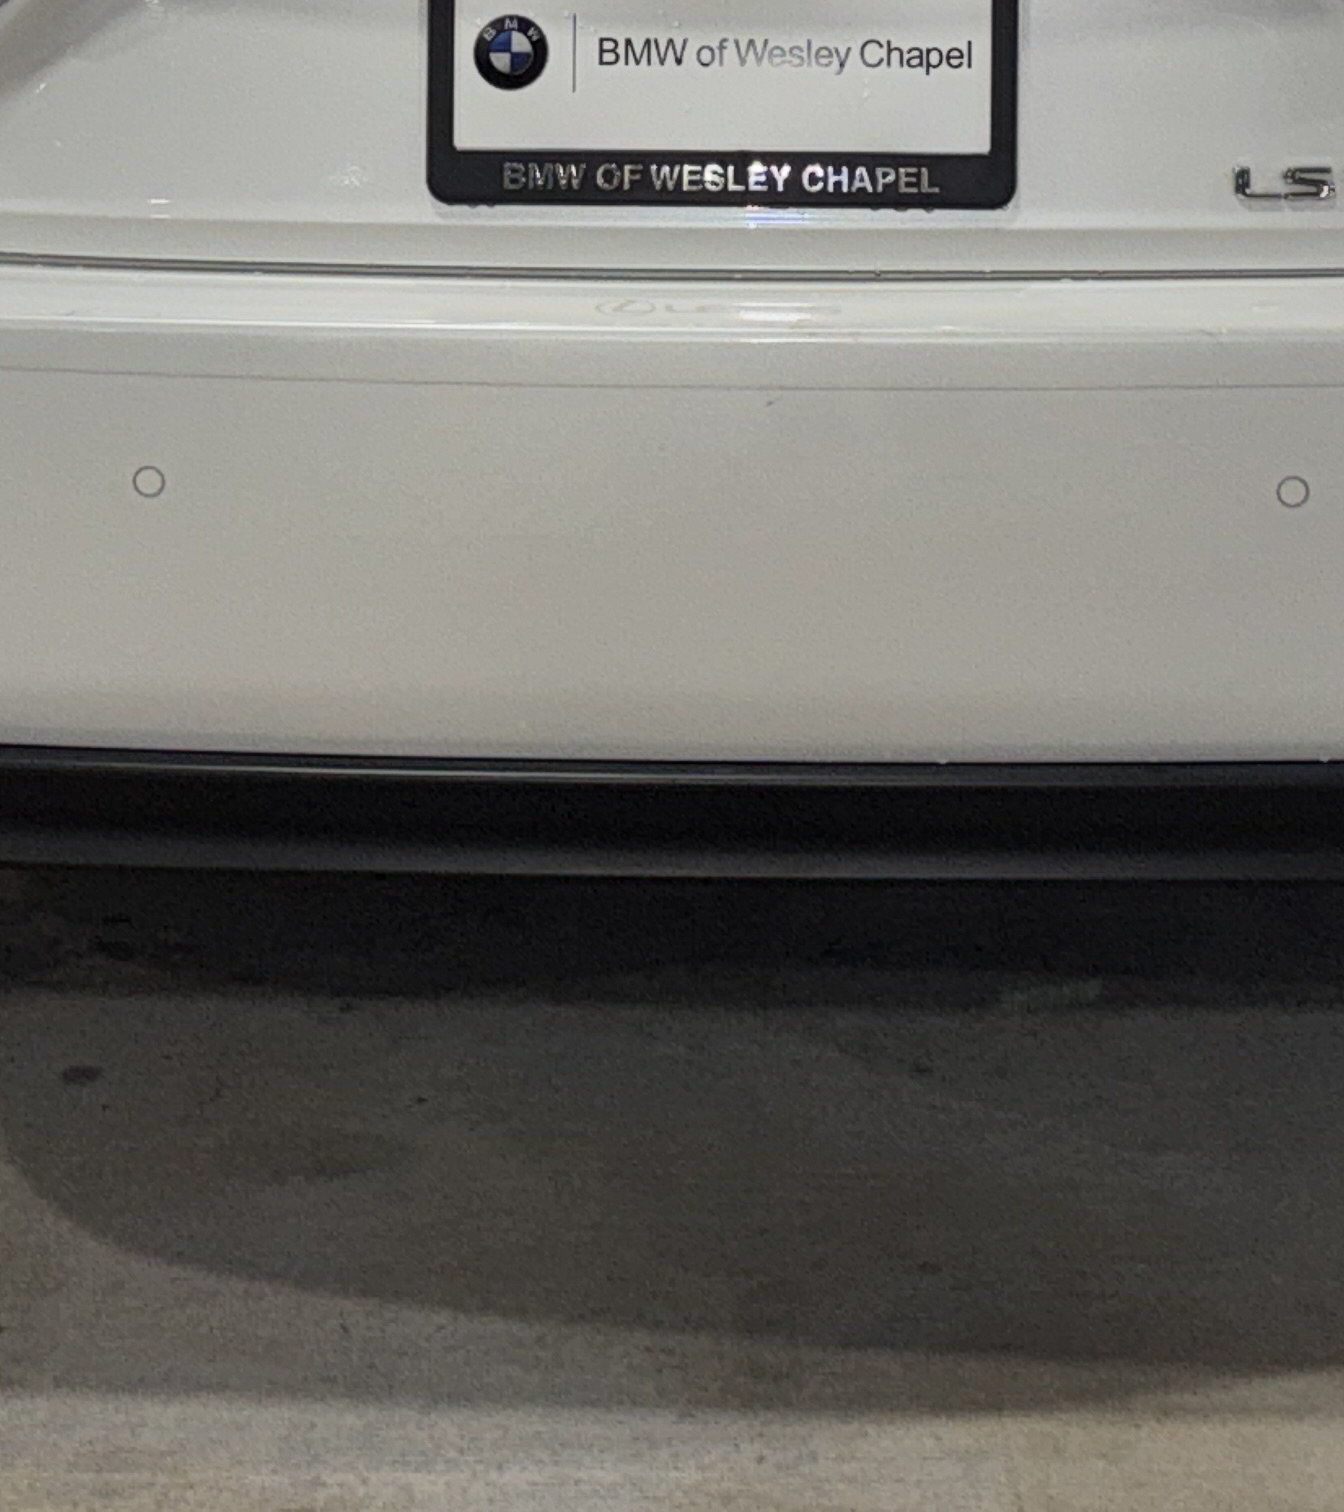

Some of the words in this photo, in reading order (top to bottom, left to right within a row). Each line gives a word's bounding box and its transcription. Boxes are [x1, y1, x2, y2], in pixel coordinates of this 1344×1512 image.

[597, 37, 688, 67] BMW
[696, 37, 730, 67] of
[733, 38, 852, 76] Wesley
[859, 39, 973, 76] Chapel
[502, 161, 587, 190] BMW
[596, 163, 644, 190] OF
[650, 162, 793, 192] WESLEY
[801, 163, 941, 194] CHAPEL
[1233, 165, 1336, 200] LS
